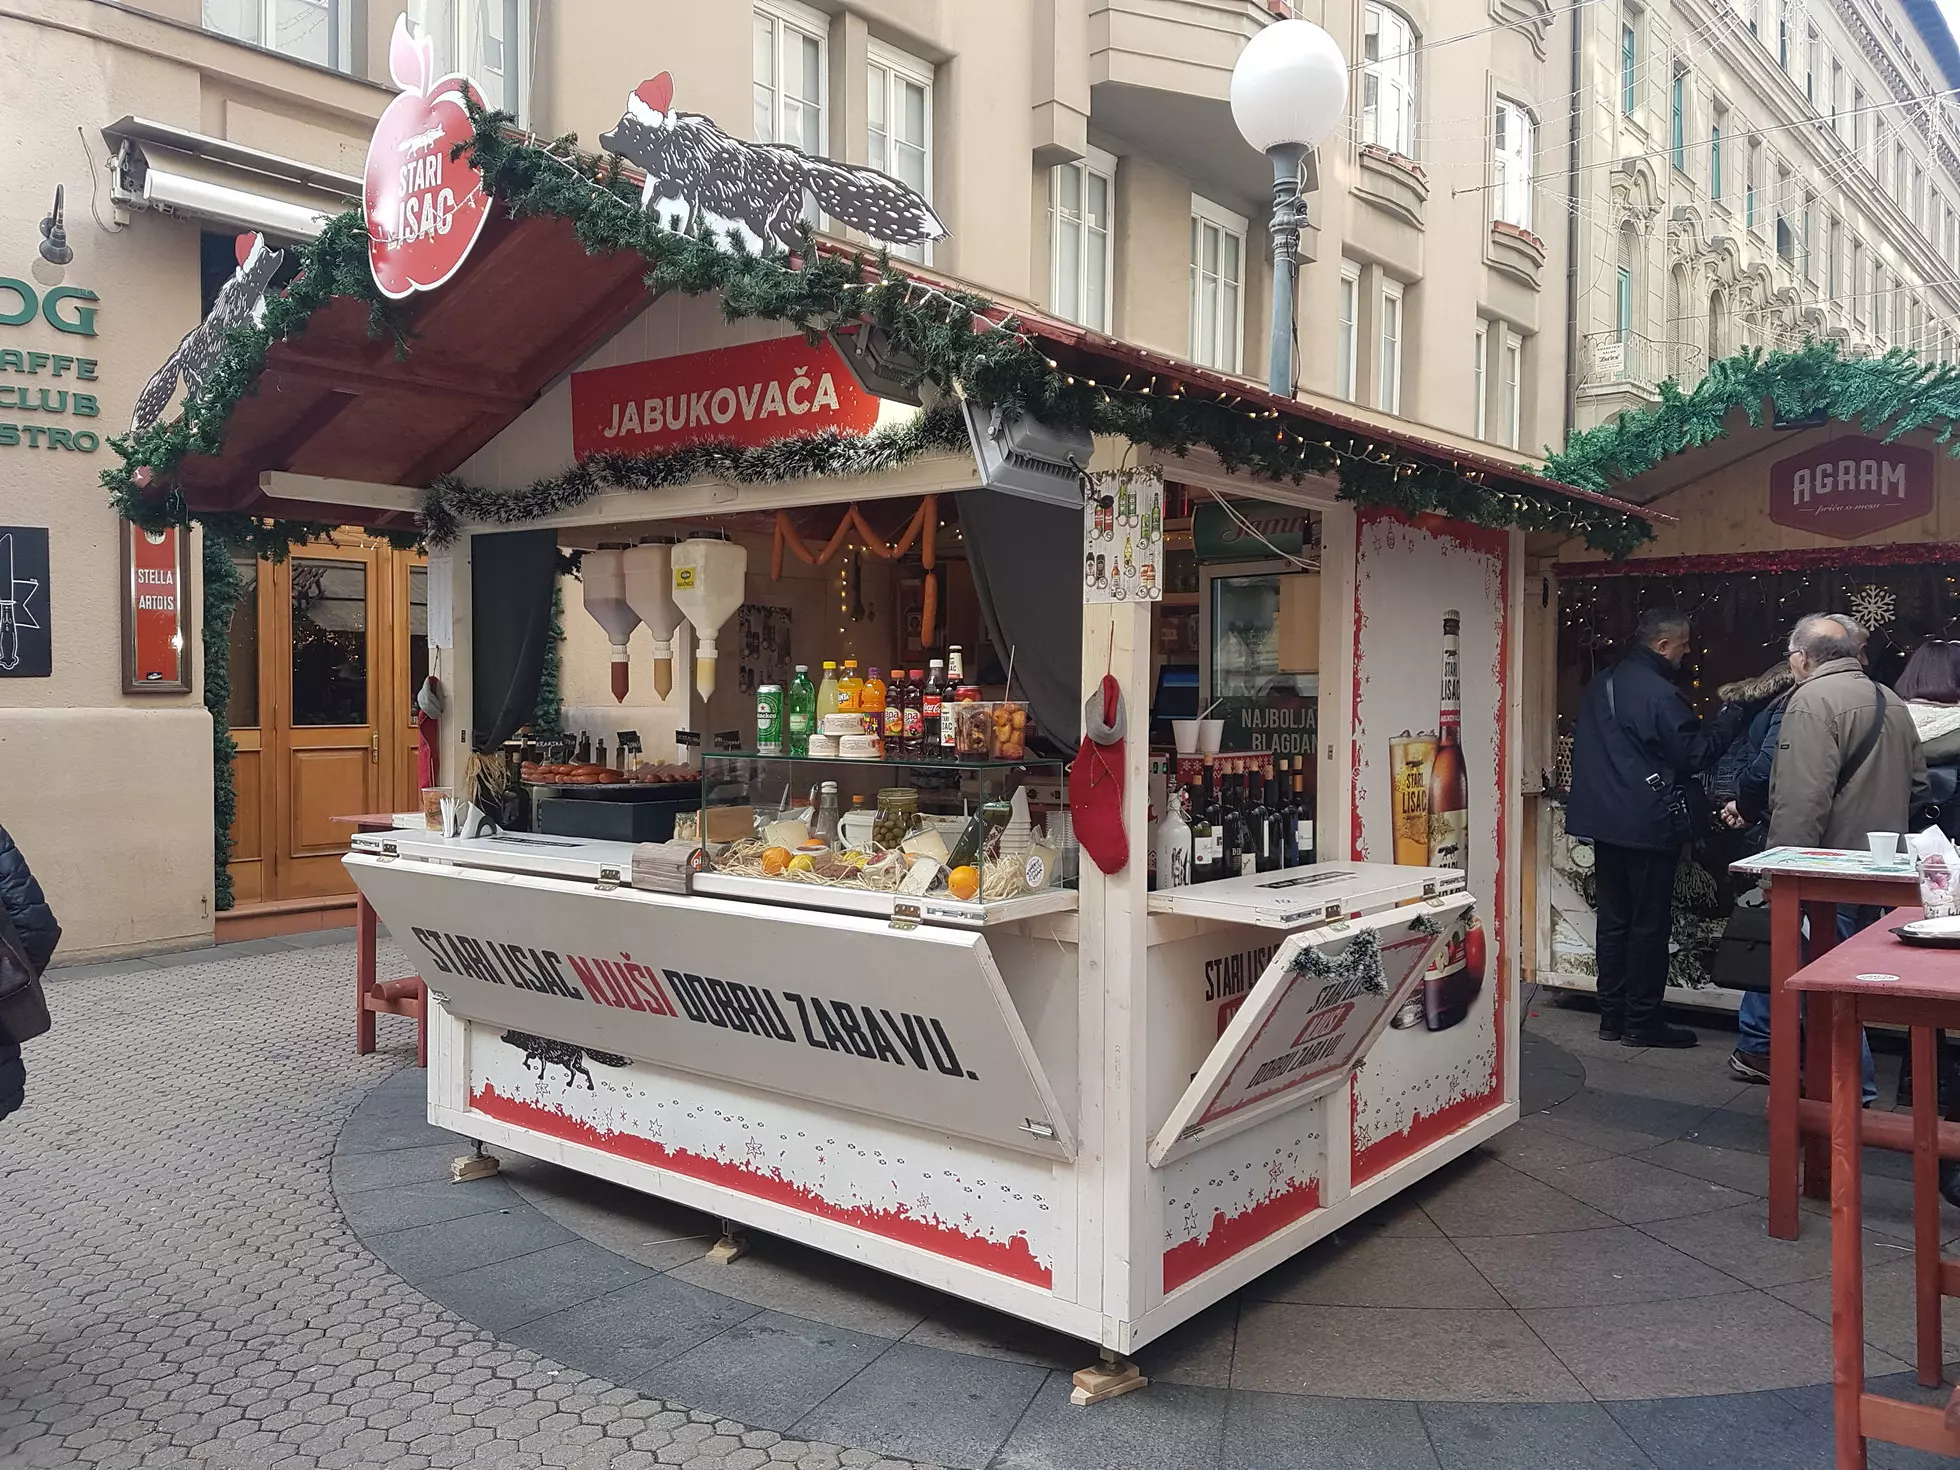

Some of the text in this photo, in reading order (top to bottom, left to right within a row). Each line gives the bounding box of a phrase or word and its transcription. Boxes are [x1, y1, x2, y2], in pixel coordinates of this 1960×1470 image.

[399, 152, 442, 197] STARI
[603, 365, 840, 438] JABUKOVAČA
[1793, 460, 1906, 505] AGRAM
[138, 569, 173, 585] STELLA
[139, 595, 174, 610] ARTOIS
[1241, 708, 1316, 729] NAJBOLJA
[1402, 789, 1427, 814] LISAC
[1205, 942, 1282, 1002] STARI LIS
[411, 926, 980, 1081] STARI LISAC NJUŠI DOBRU ZABAVU.
